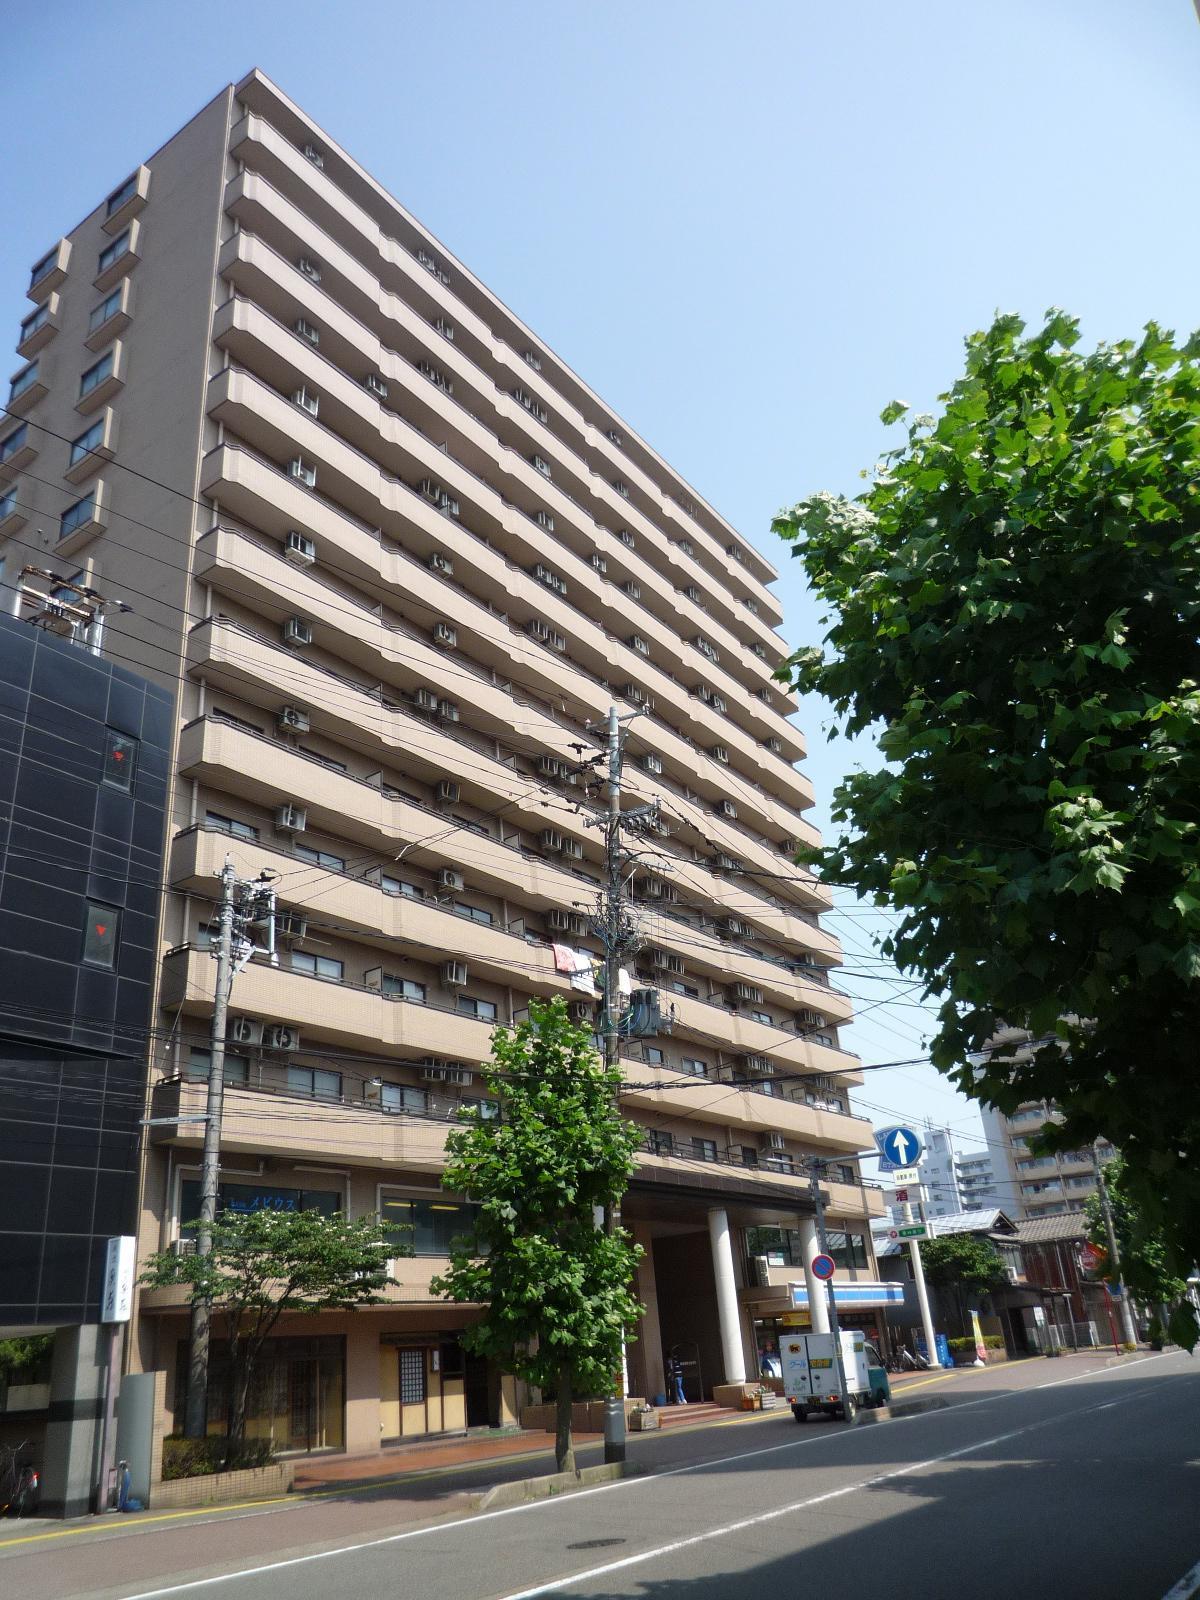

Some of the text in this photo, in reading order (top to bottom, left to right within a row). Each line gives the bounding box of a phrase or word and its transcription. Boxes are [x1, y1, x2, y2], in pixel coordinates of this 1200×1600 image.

[896, 1189, 908, 1202] 酒
[249, 1196, 295, 1211] メビウス
